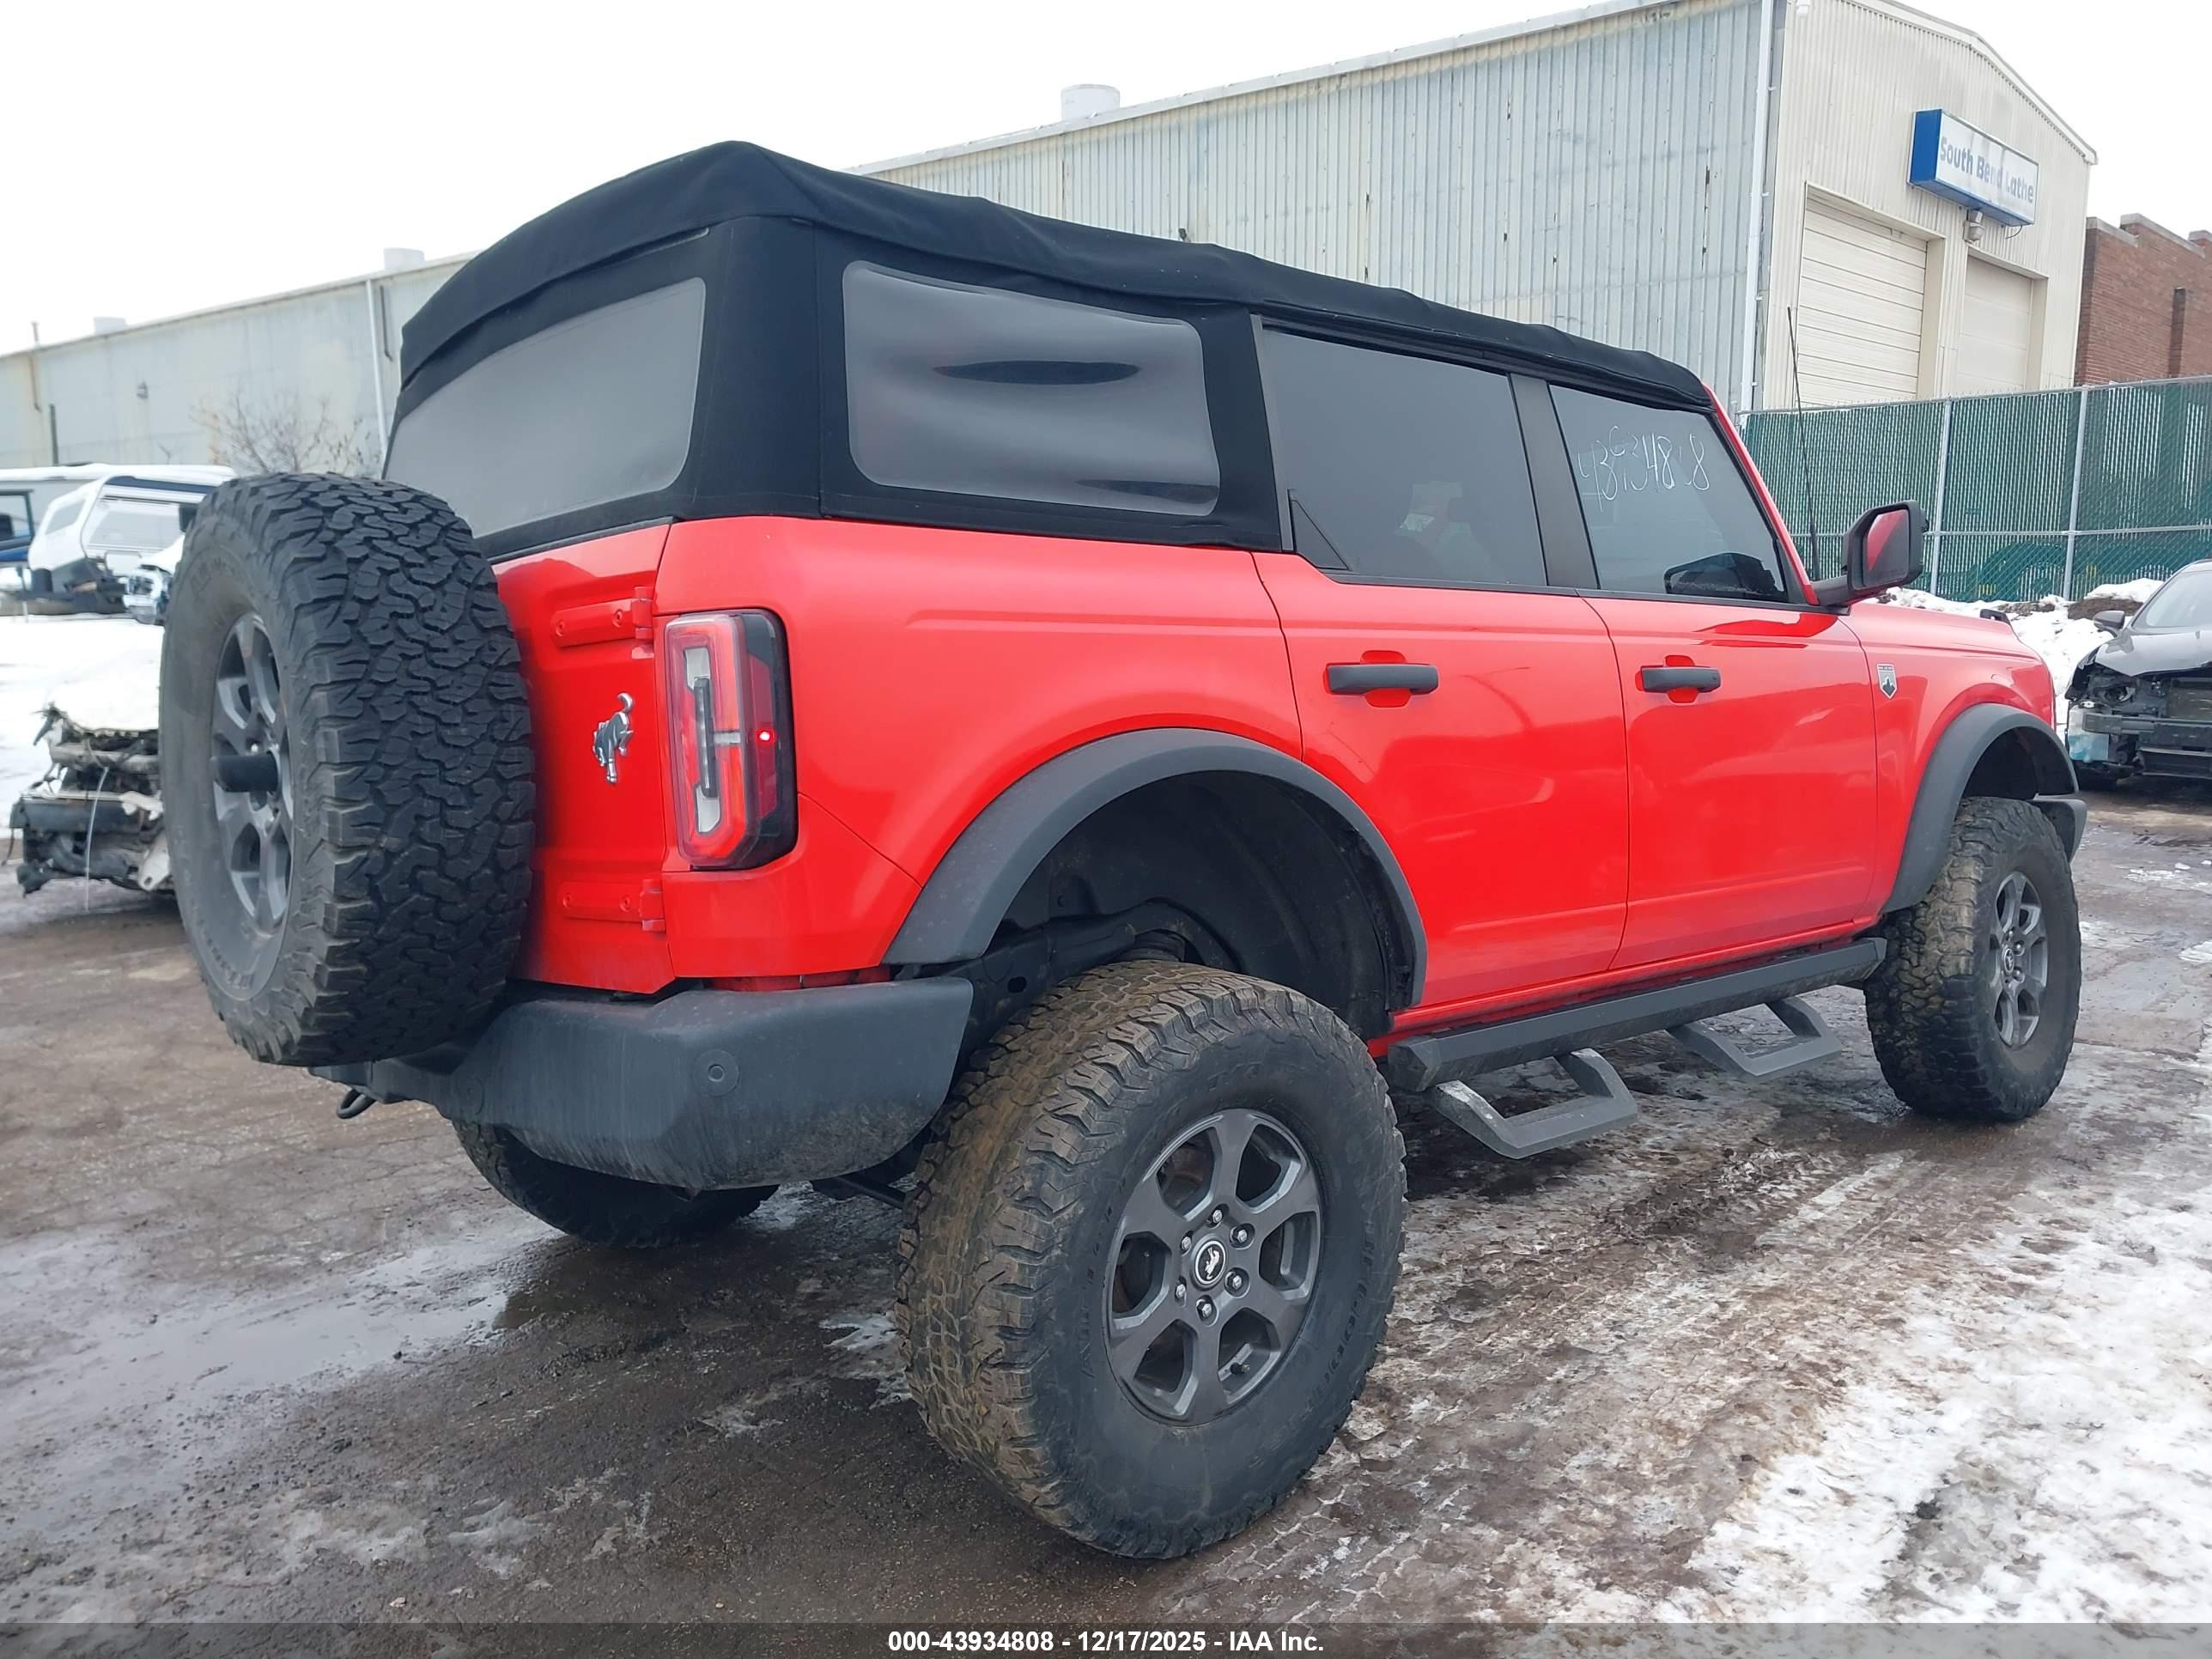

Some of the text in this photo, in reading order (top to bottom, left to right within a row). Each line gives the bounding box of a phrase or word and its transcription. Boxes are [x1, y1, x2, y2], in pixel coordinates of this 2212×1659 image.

[1940, 136, 2034, 204] South Bend Lathe
